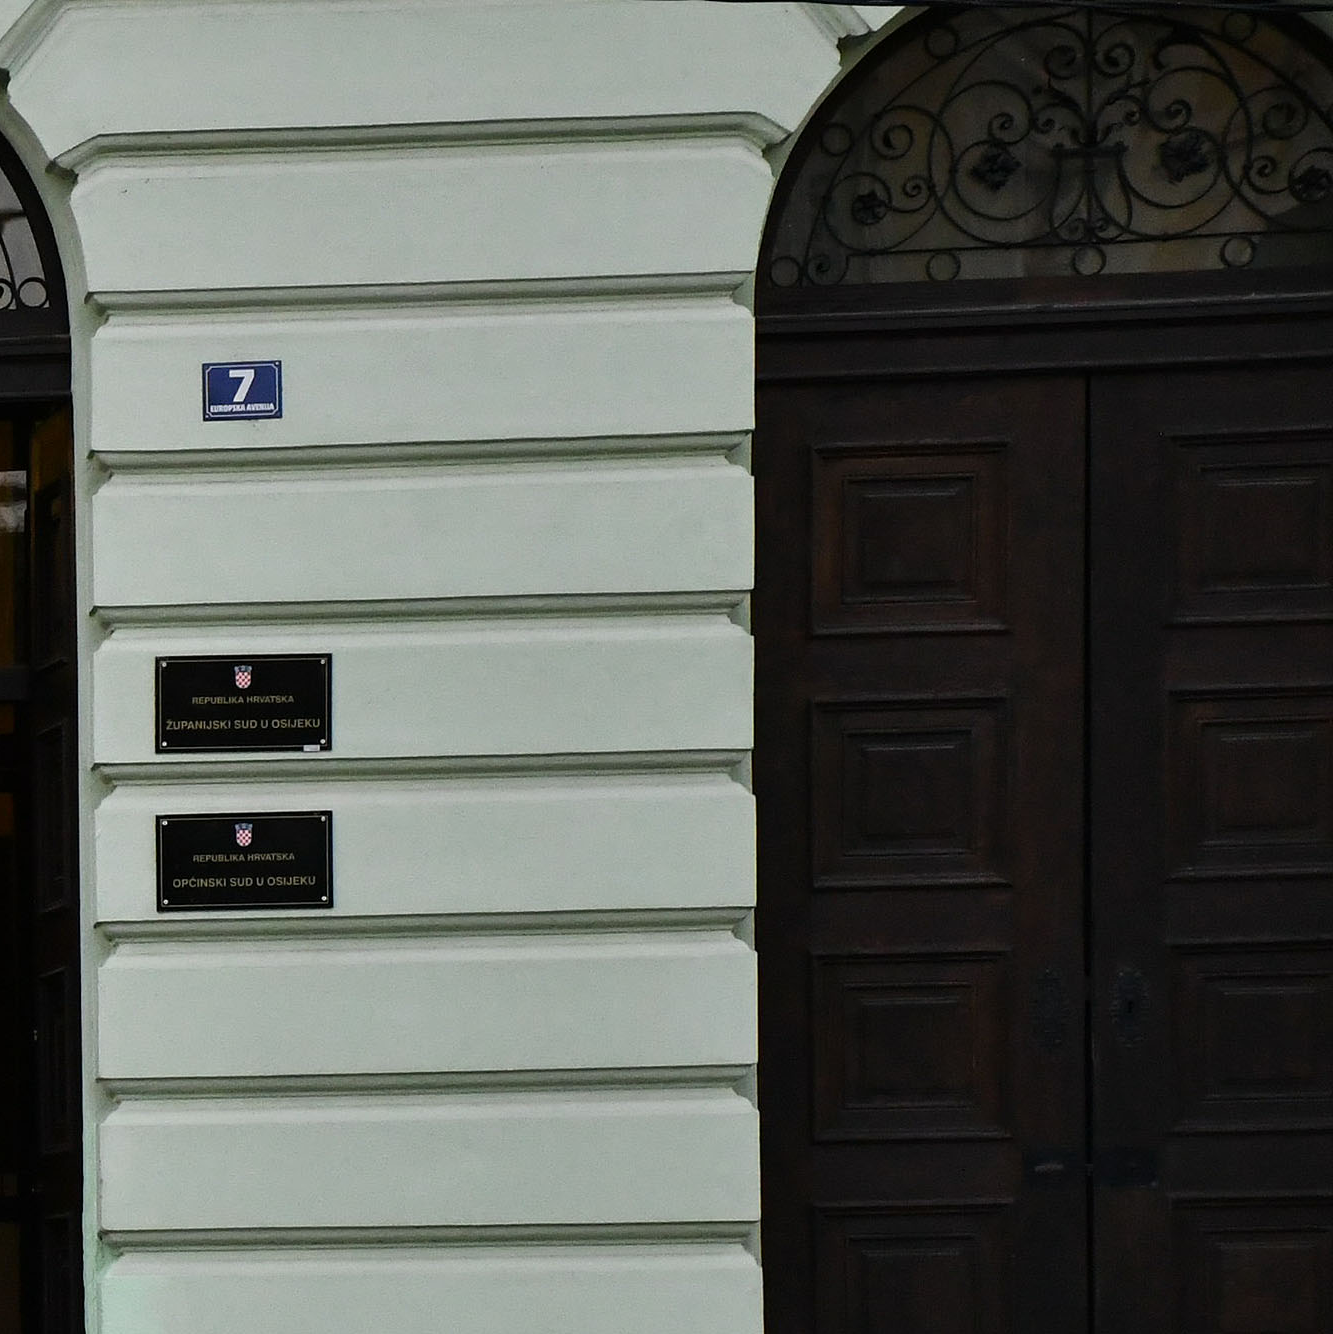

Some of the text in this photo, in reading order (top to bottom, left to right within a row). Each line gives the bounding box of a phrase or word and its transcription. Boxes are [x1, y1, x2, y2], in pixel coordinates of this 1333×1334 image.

[229, 369, 255, 402] 7
[191, 695, 294, 705] REPUBLIKA HRVATSKA
[166, 718, 321, 731] ŽUPANIJSKI SUD U OSIJEKU
[193, 852, 295, 863] REPUBLIKA HRVATSKA
[172, 875, 317, 888] OPĆINSKI SUD U OSIJEKU
